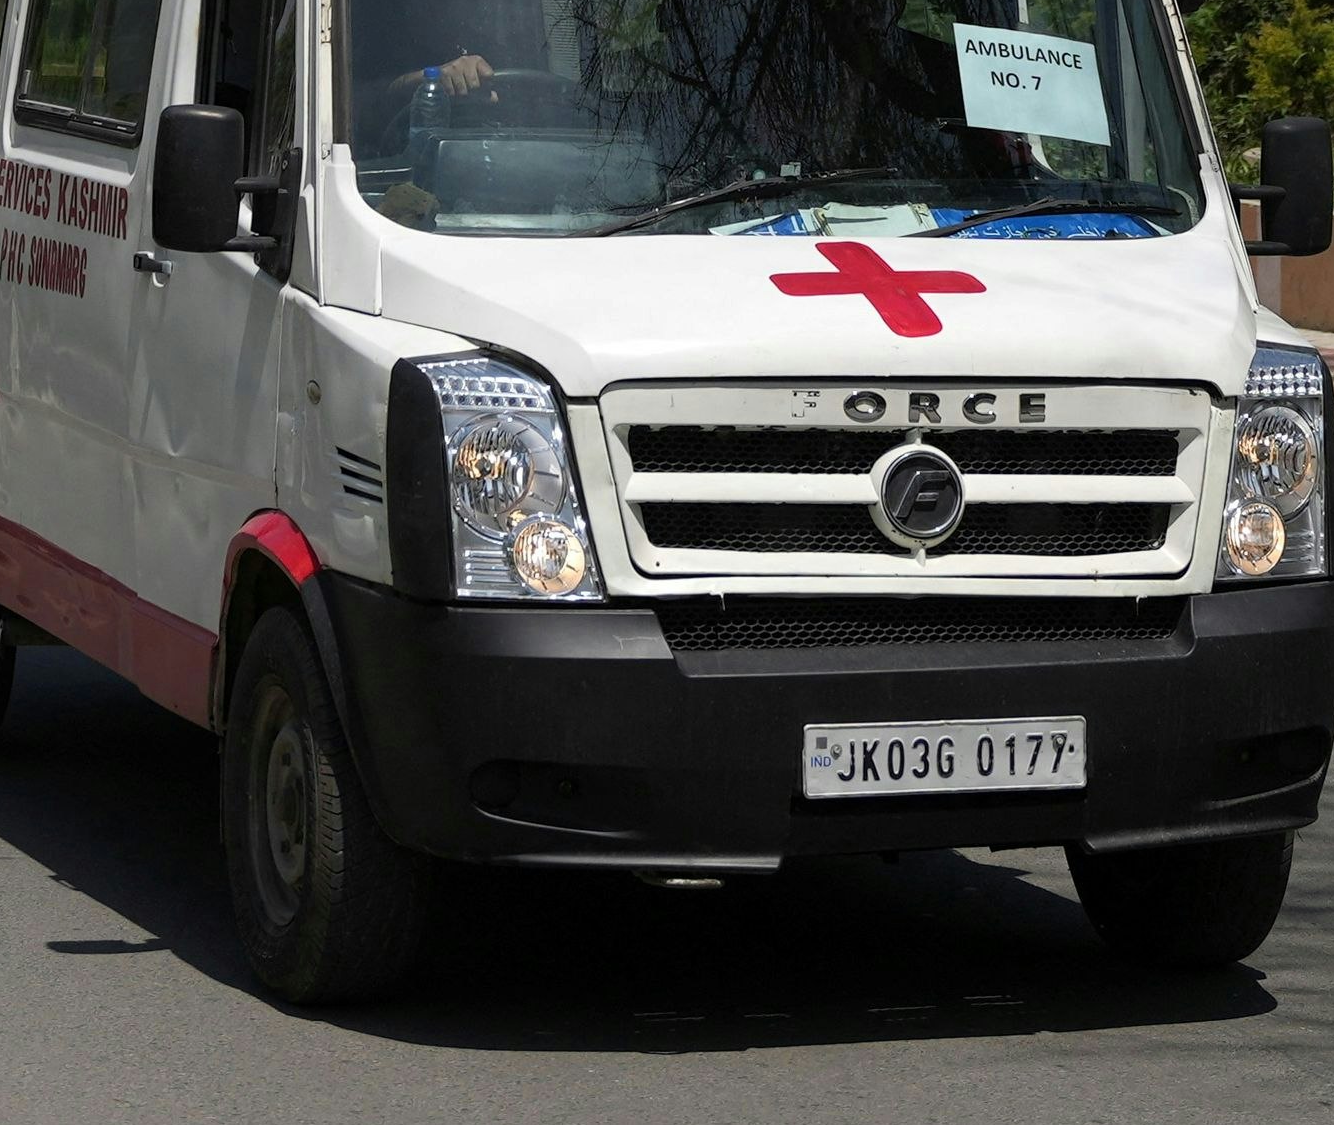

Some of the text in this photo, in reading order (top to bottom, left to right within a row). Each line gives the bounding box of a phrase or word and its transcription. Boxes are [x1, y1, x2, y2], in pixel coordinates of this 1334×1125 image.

[965, 39, 1083, 69] AMBULANCE
[991, 71, 1042, 91] NO. 7
[57, 173, 129, 240] KASHMIR
[810, 756, 832, 768] IND
[837, 736, 955, 782] JK03G
